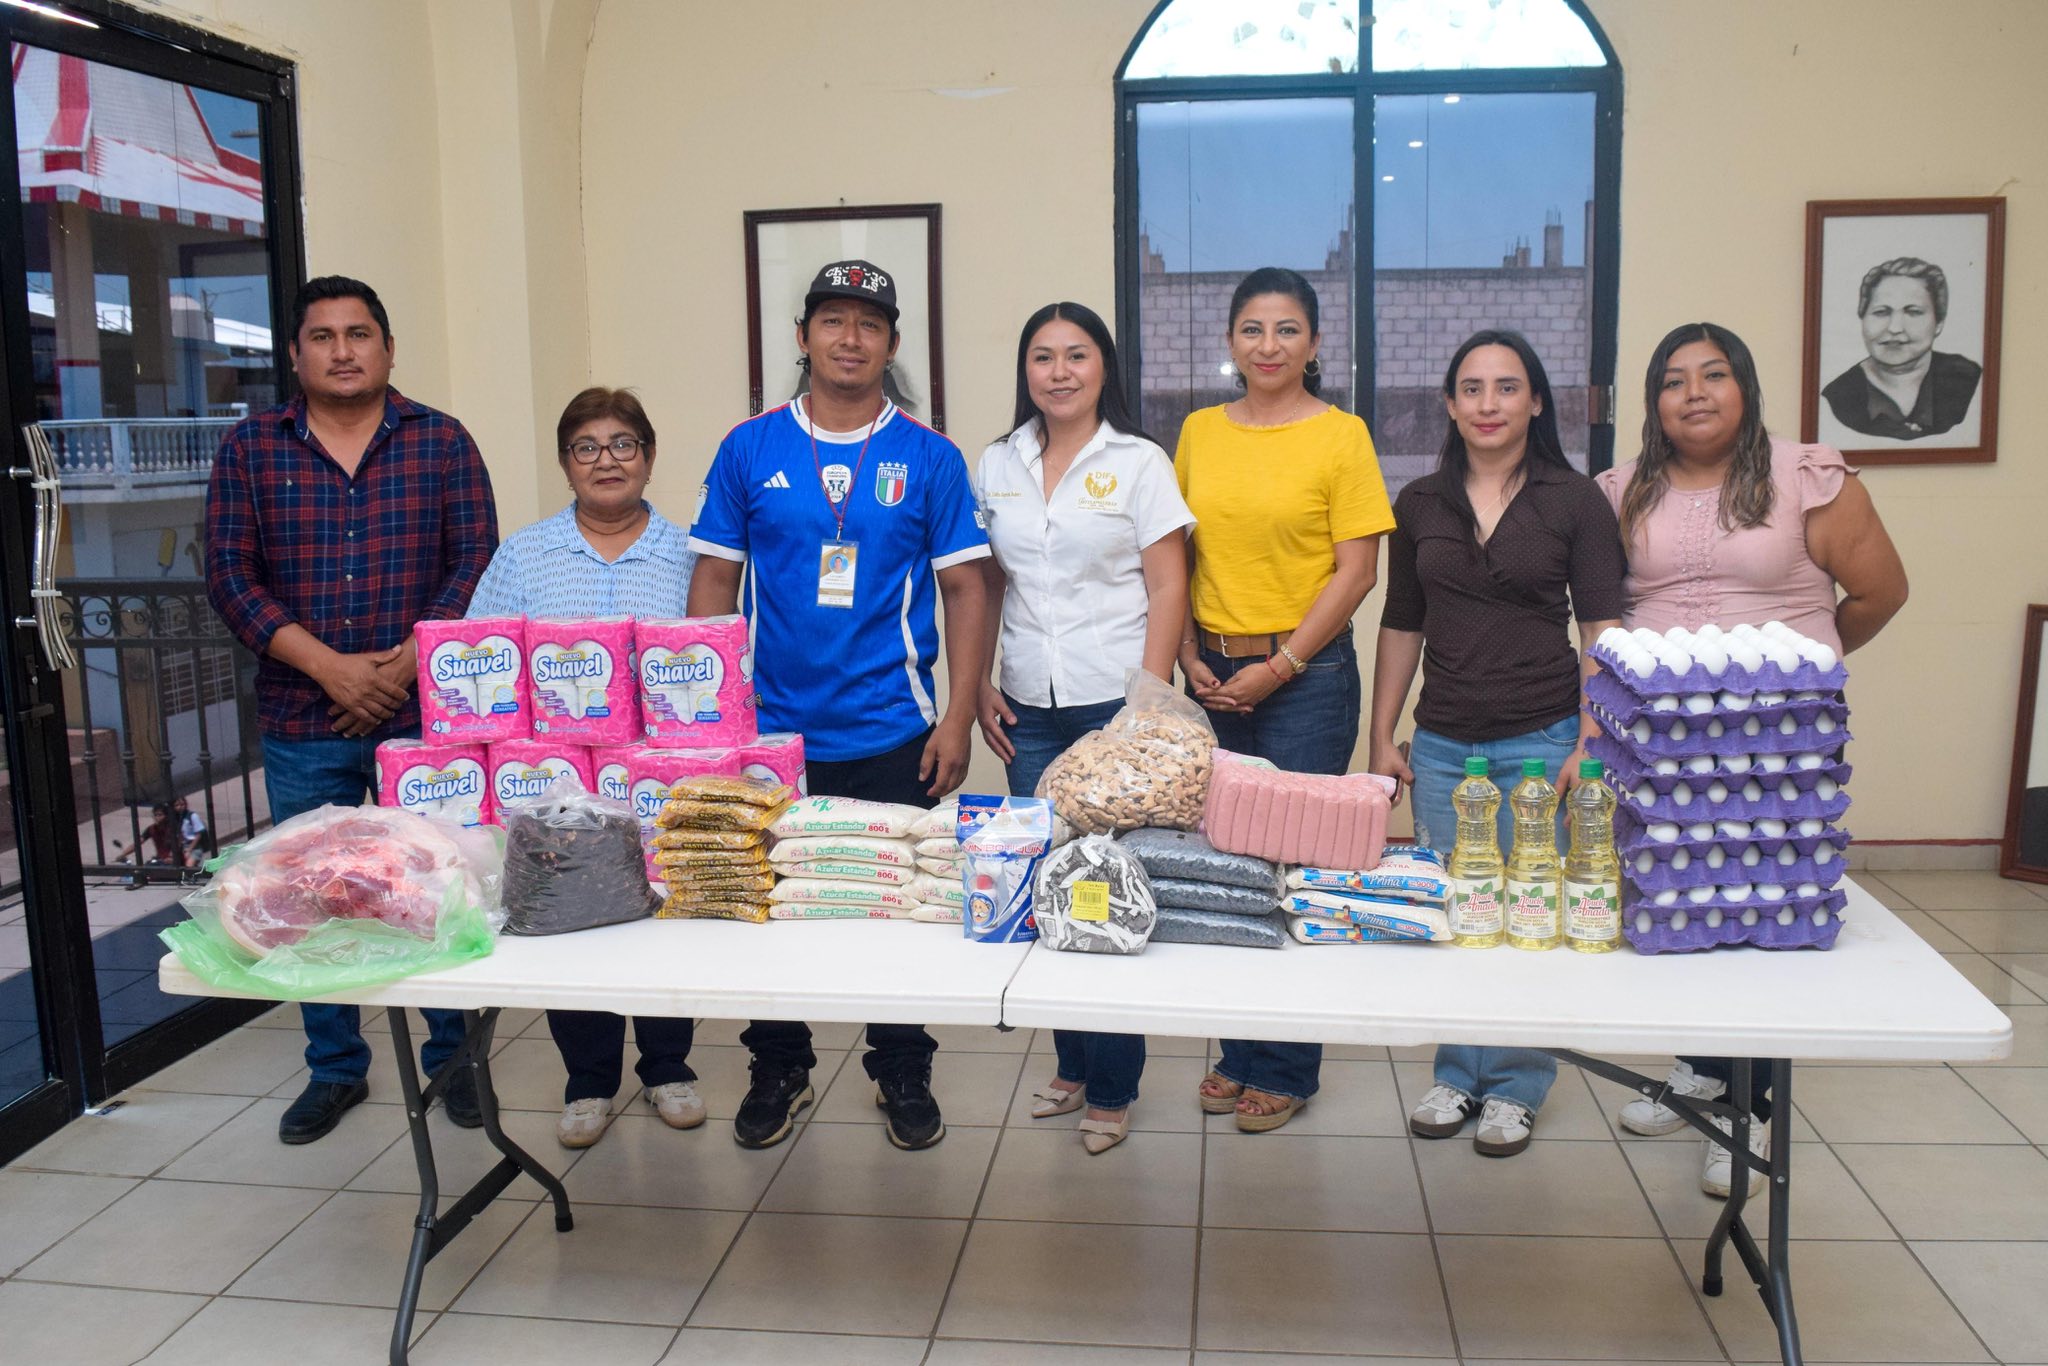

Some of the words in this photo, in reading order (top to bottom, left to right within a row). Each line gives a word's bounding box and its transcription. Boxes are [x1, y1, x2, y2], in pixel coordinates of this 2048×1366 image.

[880, 469, 905, 479] ITALIA
[464, 649, 489, 657] NUEVO
[437, 648, 512, 681] Suavel
[669, 656, 691, 664] NUEVO
[536, 653, 603, 682] Suavel
[645, 657, 714, 686] Suavel
[431, 719, 442, 733] 4
[534, 719, 542, 732] 4
[432, 772, 455, 781] NUEVO
[404, 770, 477, 805] Suavel
[877, 871, 892, 879] 800
[1470, 892, 1495, 901] Abuela
[1519, 895, 1544, 905] Abuela
[1580, 897, 1606, 906] Abuela
[1458, 901, 1498, 911] Amada
[1510, 903, 1548, 914] Amada
[1571, 905, 1610, 916] Amada
